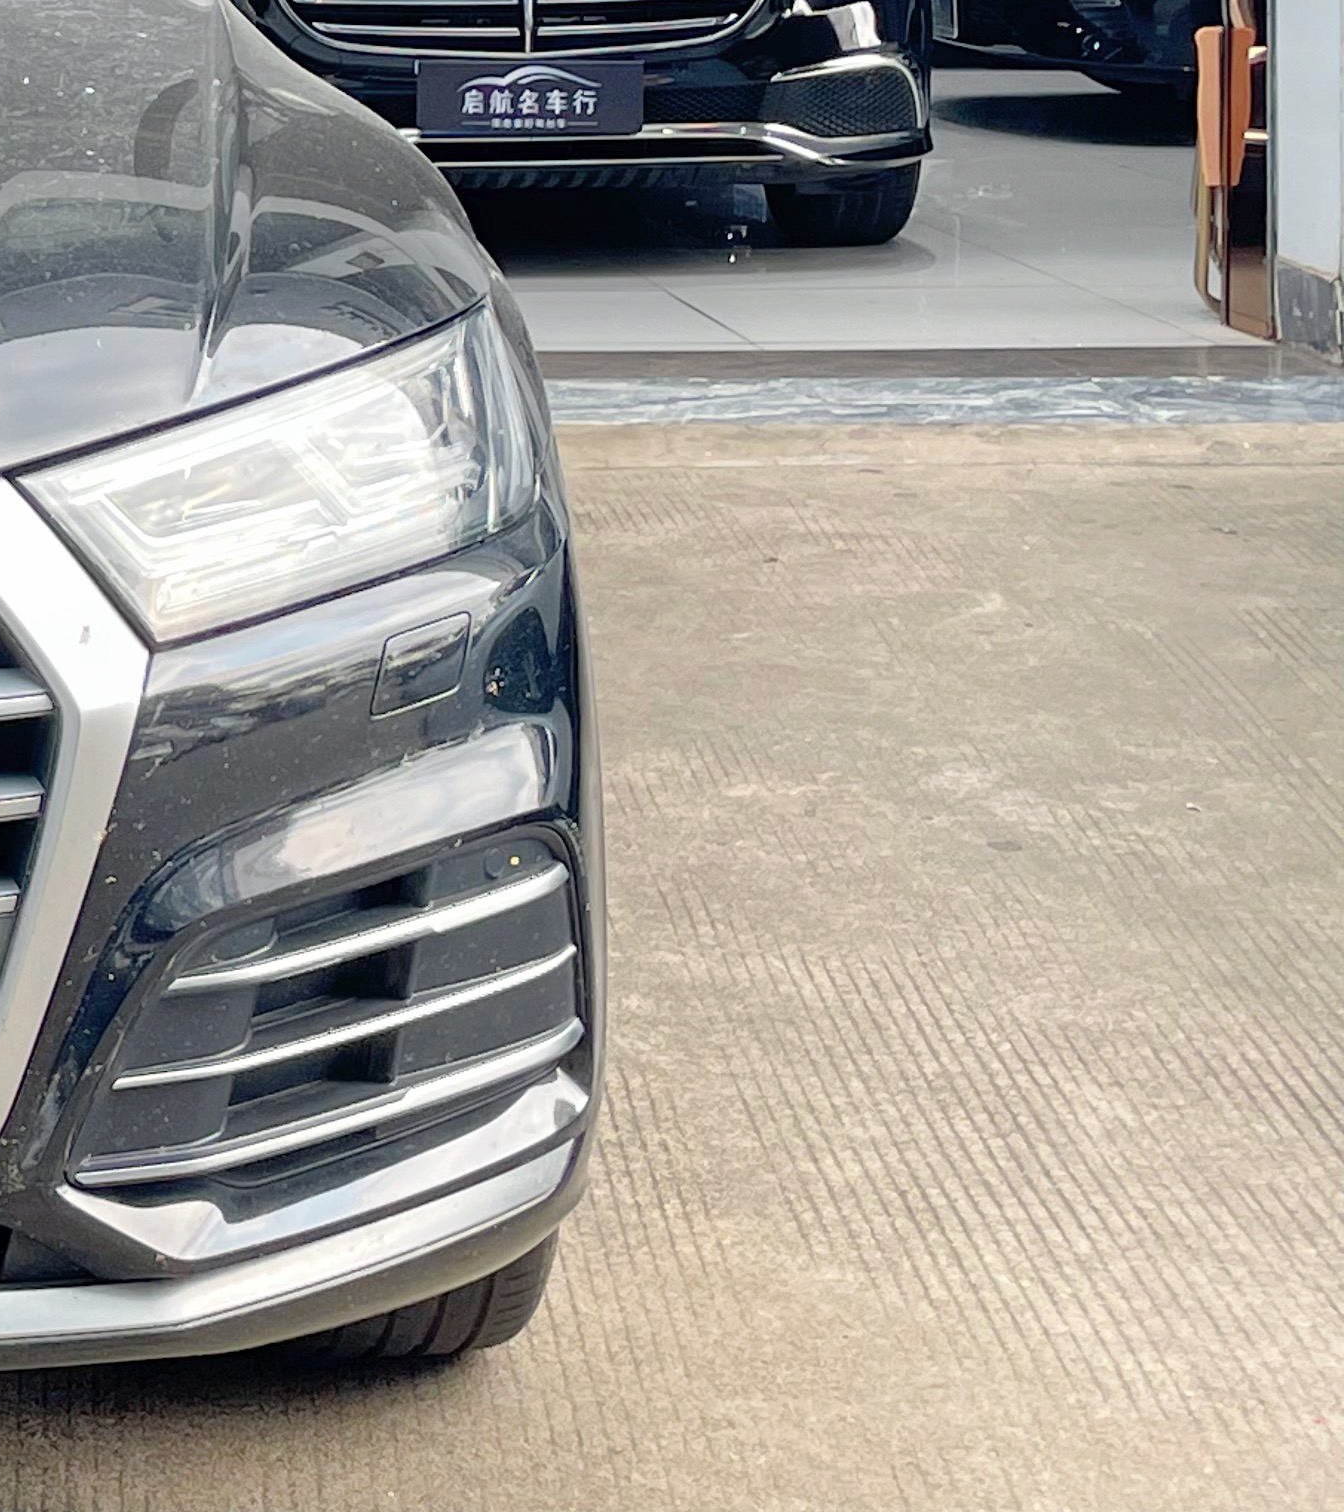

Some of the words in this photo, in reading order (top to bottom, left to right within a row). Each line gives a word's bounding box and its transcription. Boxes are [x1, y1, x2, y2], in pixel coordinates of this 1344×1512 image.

[461, 88, 598, 115] 启航名车行
